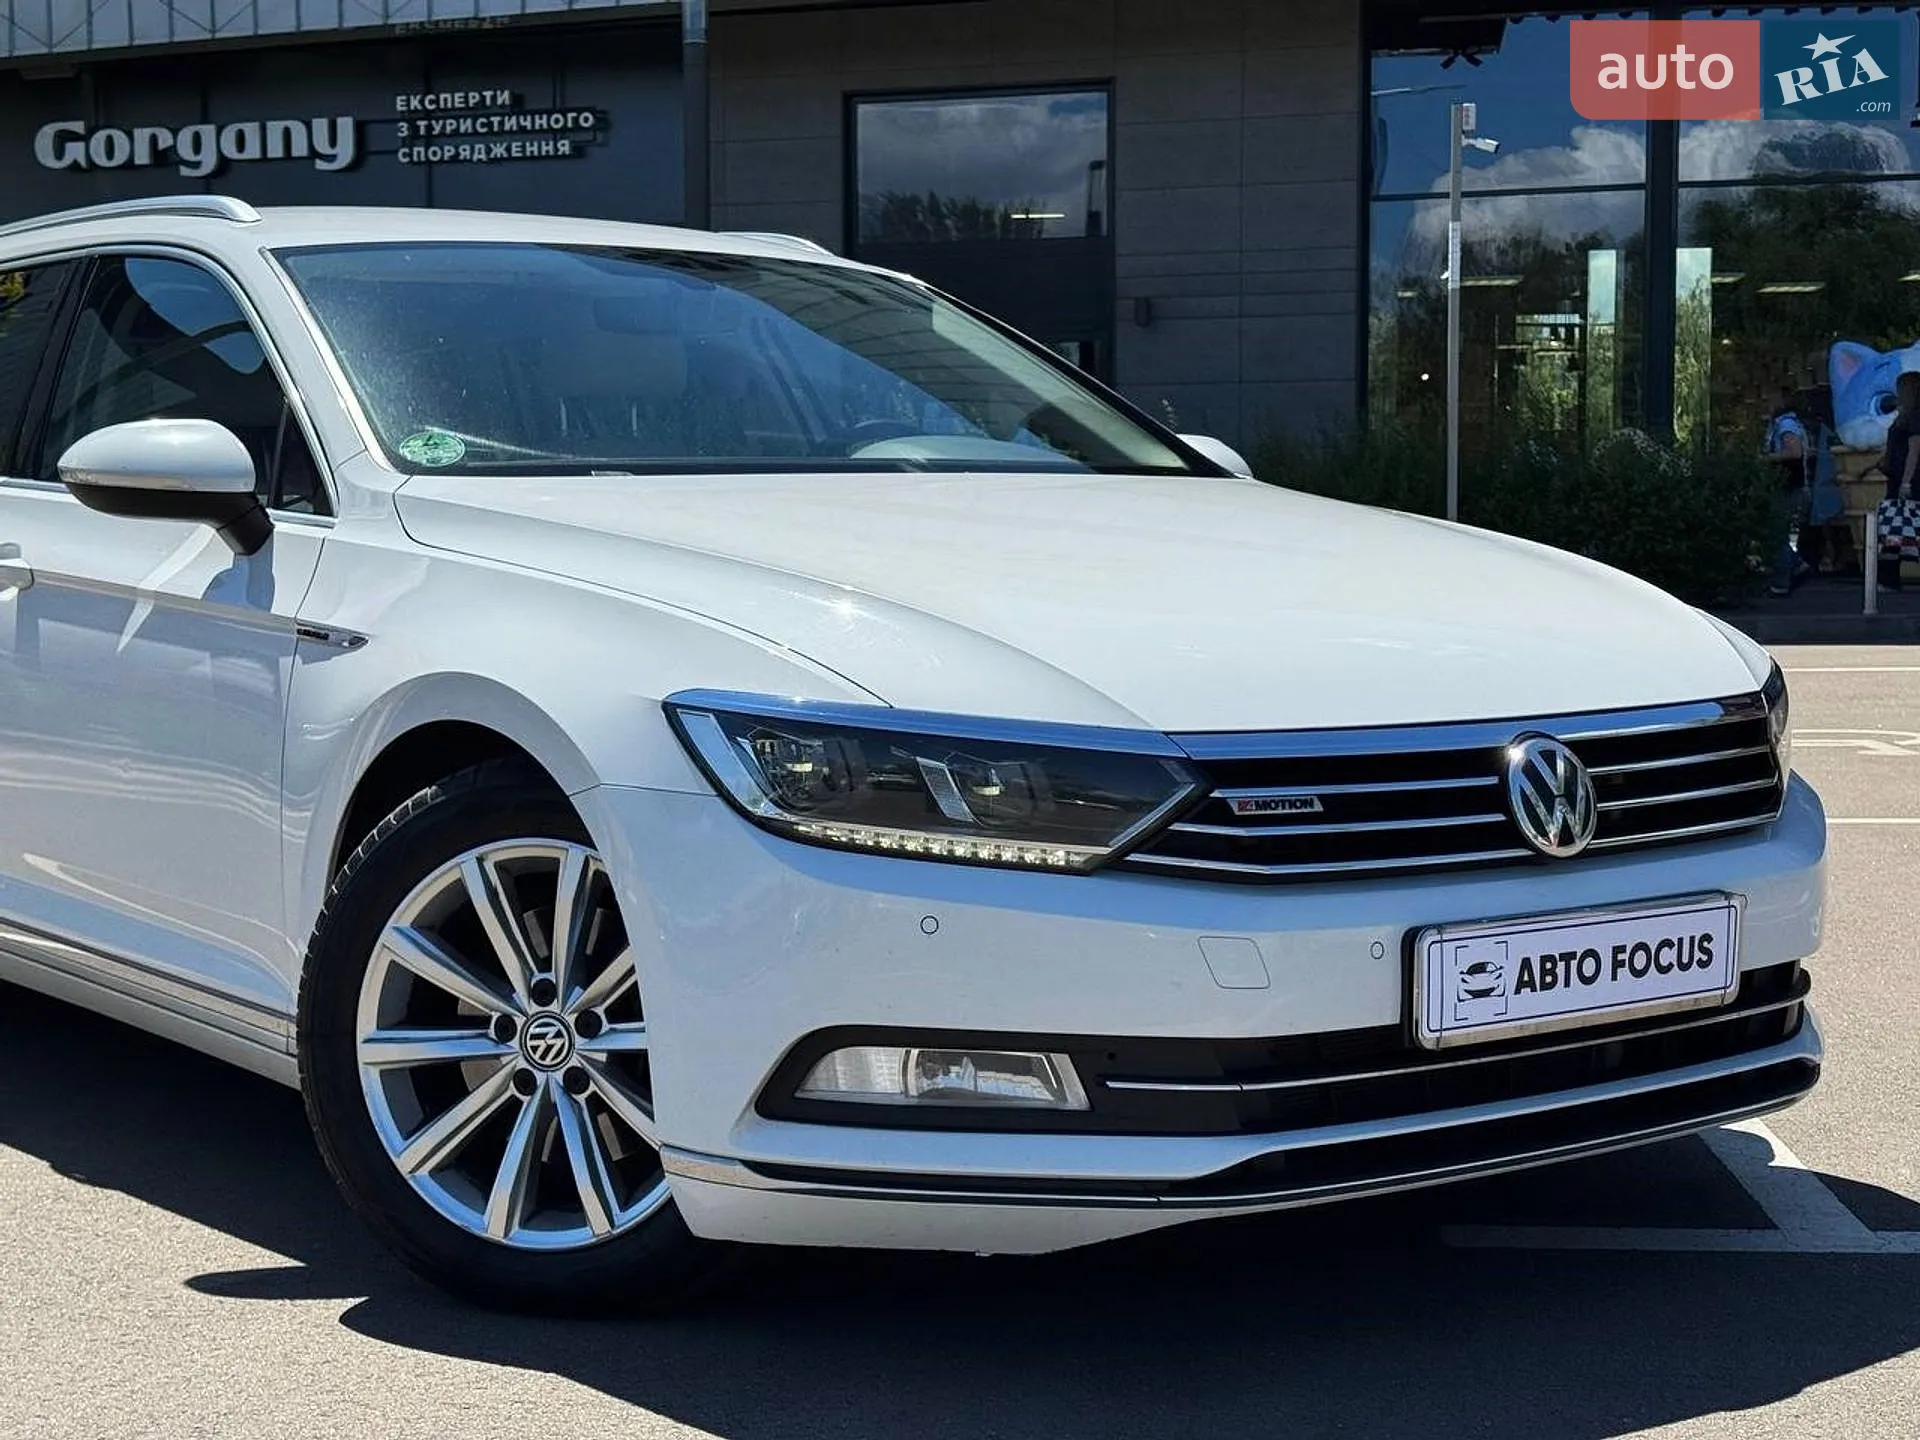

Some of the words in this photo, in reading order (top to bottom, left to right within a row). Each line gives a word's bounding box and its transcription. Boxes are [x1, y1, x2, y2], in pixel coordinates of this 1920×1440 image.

[396, 90, 510, 111] ЕКСПЕРТИ
[415, 112, 595, 136] ТУРИСТИЧНОГО
[34, 116, 354, 177] Gorgany
[398, 139, 571, 163] СПОРЯДЖЕННЯ
[1611, 932, 1714, 982] FOCUS
